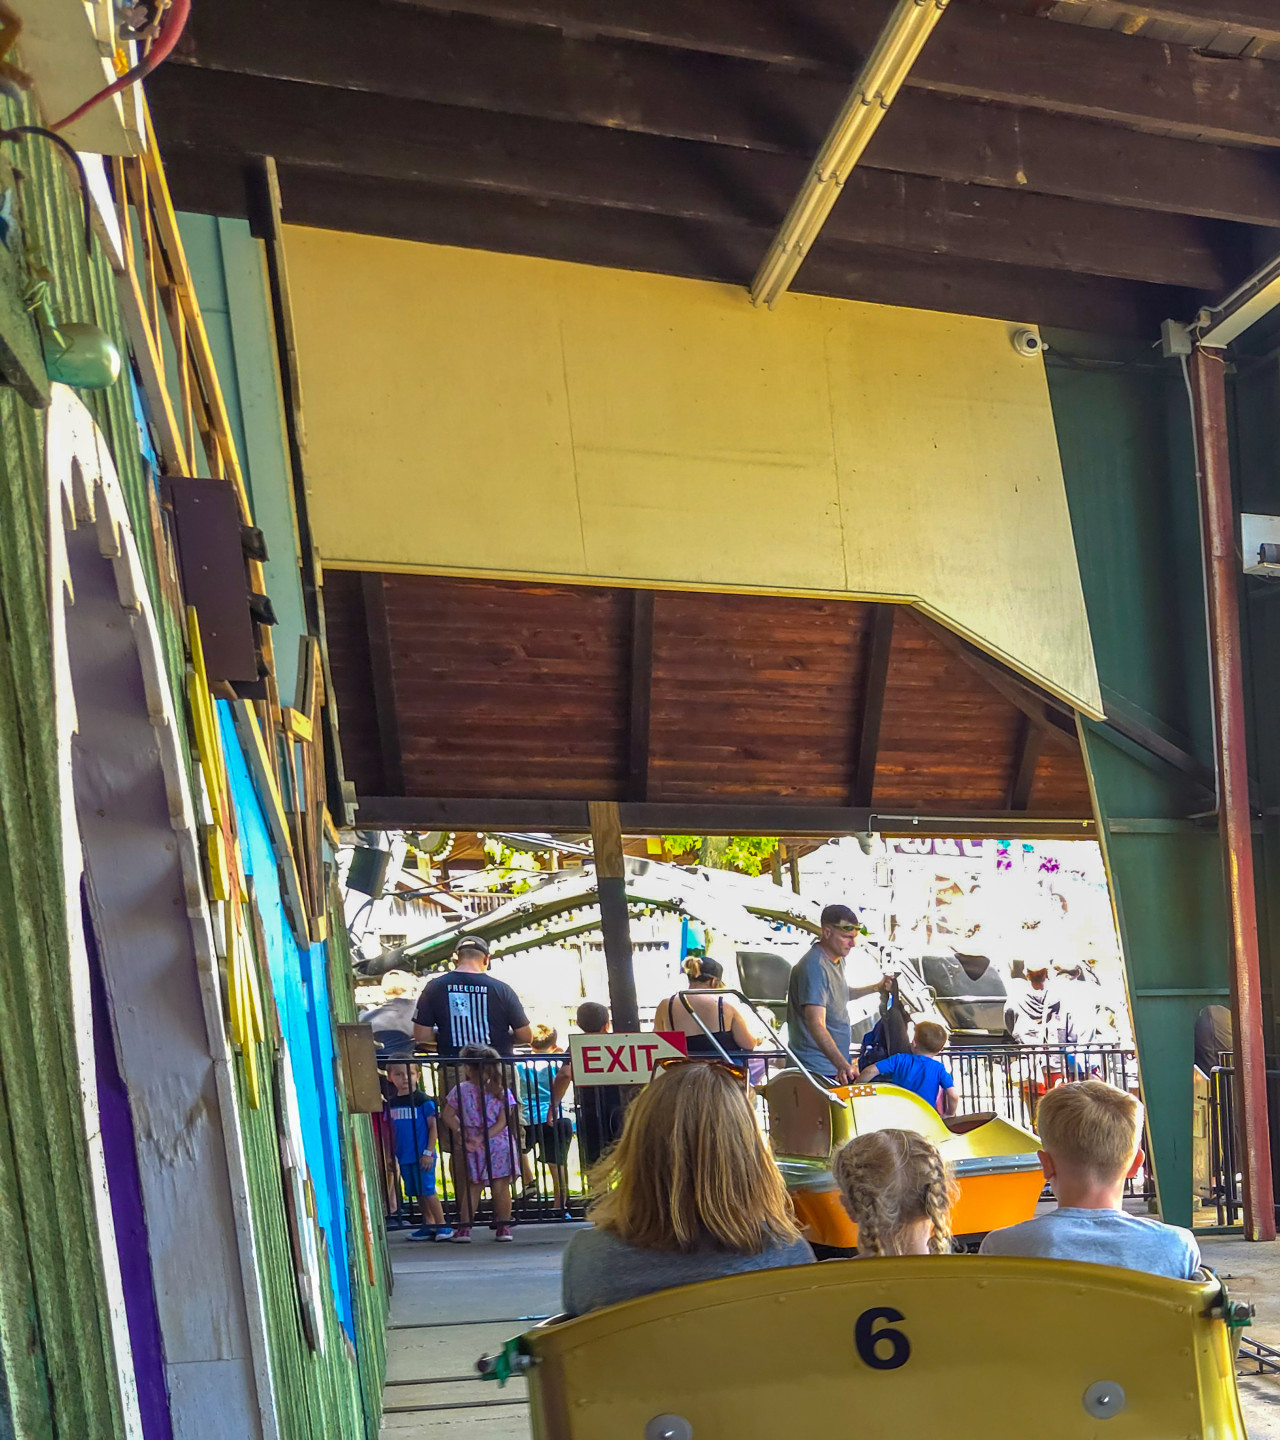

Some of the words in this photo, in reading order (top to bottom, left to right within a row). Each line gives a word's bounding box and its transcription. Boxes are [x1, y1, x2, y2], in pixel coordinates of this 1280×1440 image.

[447, 984, 488, 993] FREEDOM
[581, 1044, 659, 1073] EXIT
[854, 1306, 911, 1370] 6
